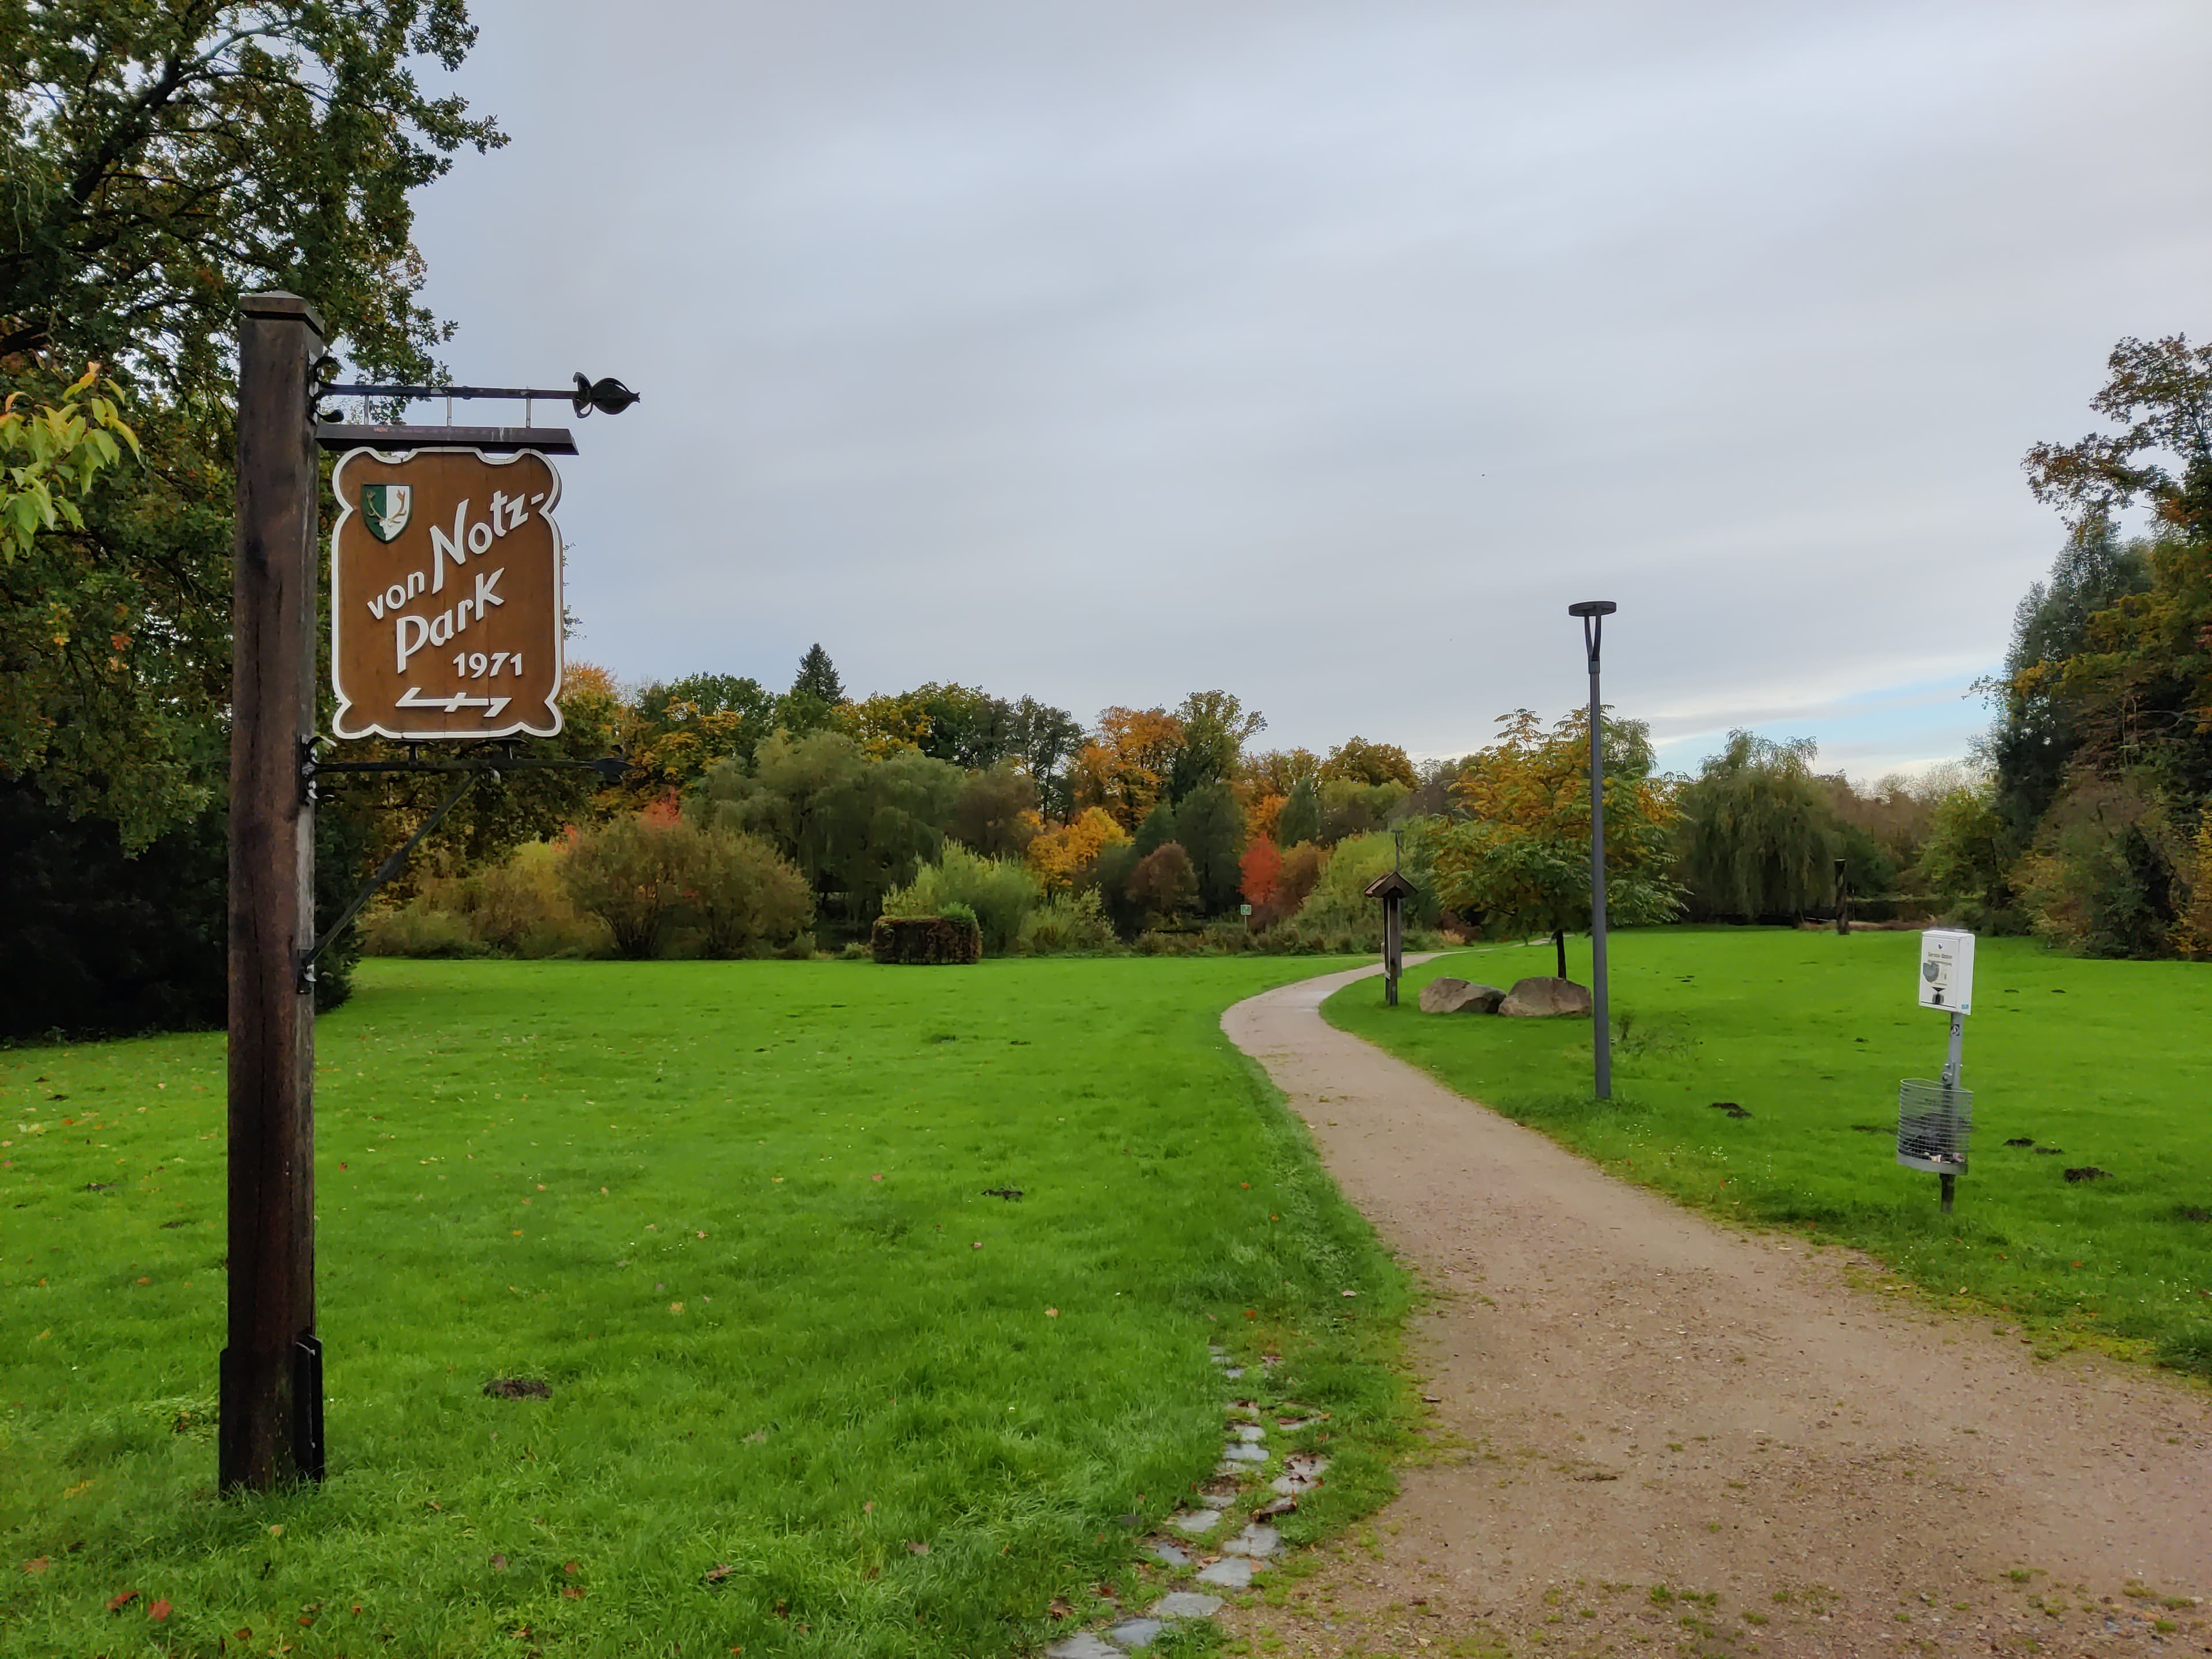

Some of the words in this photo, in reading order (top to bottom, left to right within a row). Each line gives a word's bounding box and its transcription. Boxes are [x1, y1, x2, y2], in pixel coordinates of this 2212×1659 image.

[367, 571, 425, 619] von
[430, 490, 544, 594] Notz-
[453, 652, 523, 678] 1971
